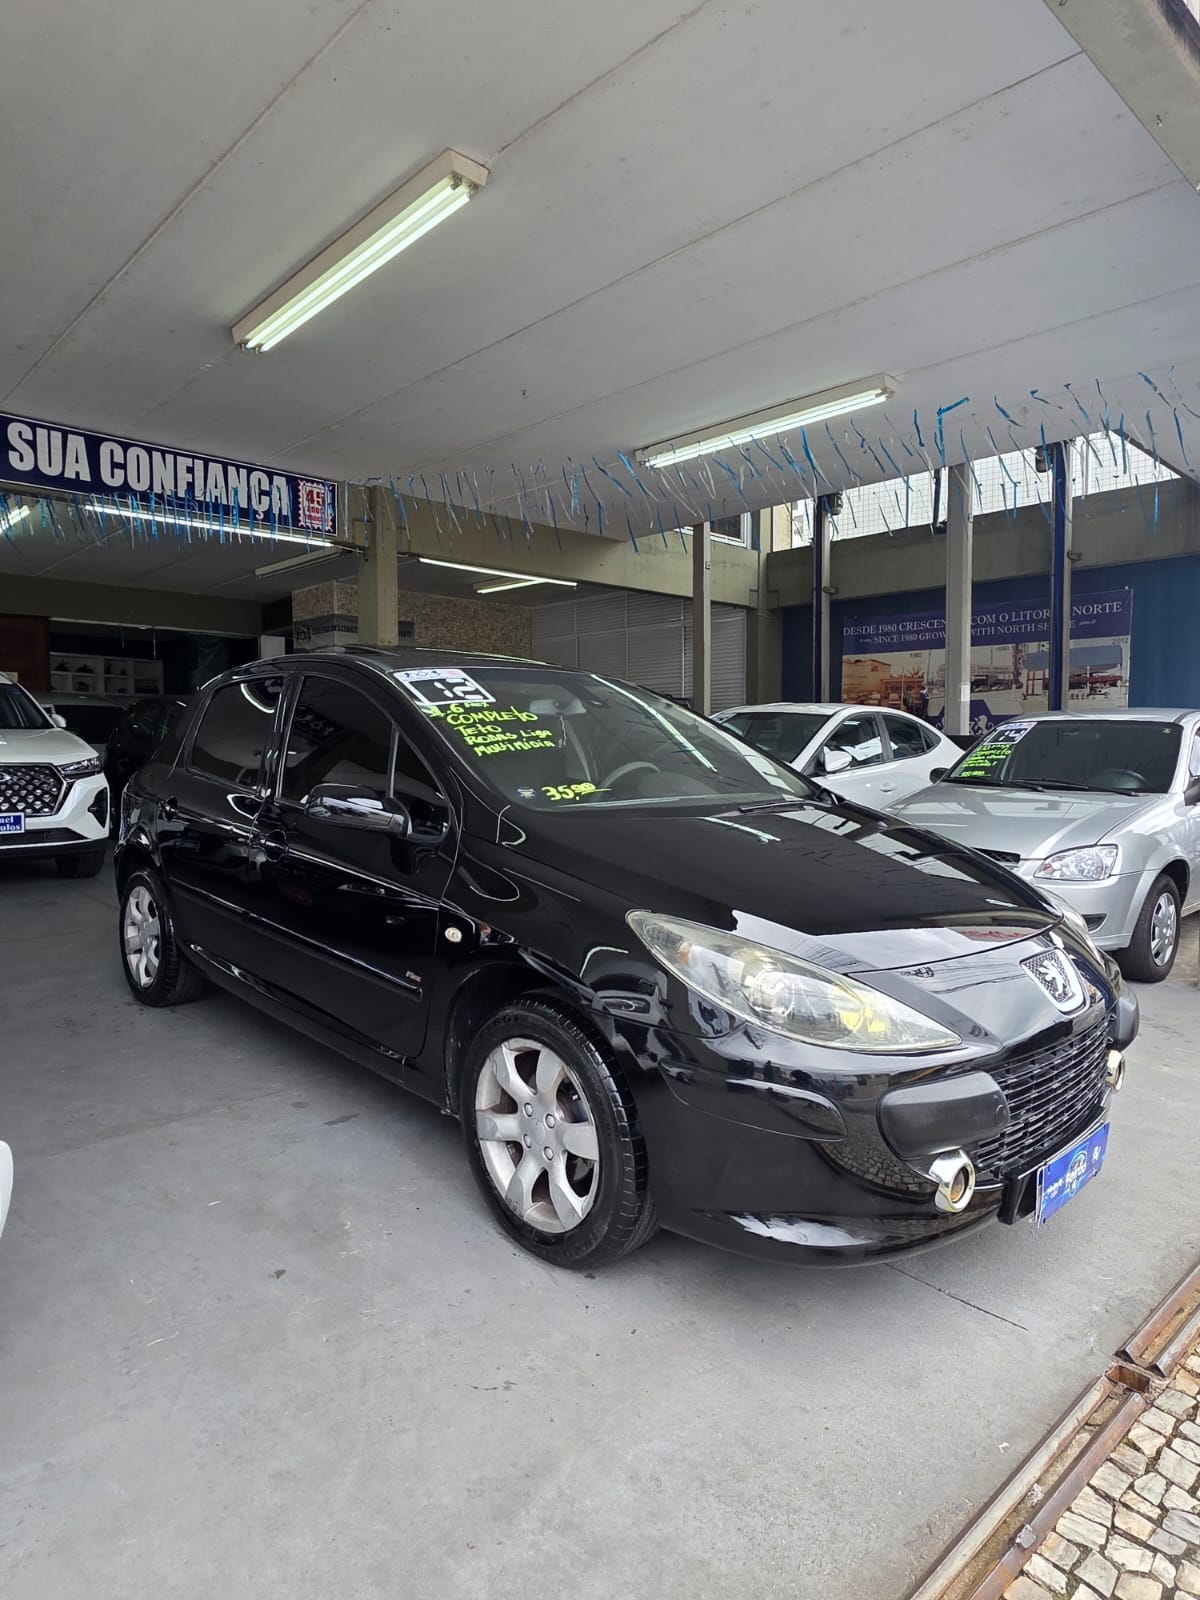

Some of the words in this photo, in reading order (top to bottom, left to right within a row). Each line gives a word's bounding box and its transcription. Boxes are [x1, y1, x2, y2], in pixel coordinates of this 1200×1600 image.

[7, 421, 91, 481] SUA
[100, 441, 289, 519] CONFIANÇA
[843, 625, 877, 636] DESDE
[879, 624, 896, 633] 1980
[899, 619, 946, 631] CRESCEN
[999, 612, 1008, 622] O
[1012, 609, 1050, 621] LITOR
[1072, 602, 1122, 616] NORTE
[873, 635, 900, 644] SINCE
[919, 631, 946, 641] GROW
[998, 623, 1035, 634] NORTH
